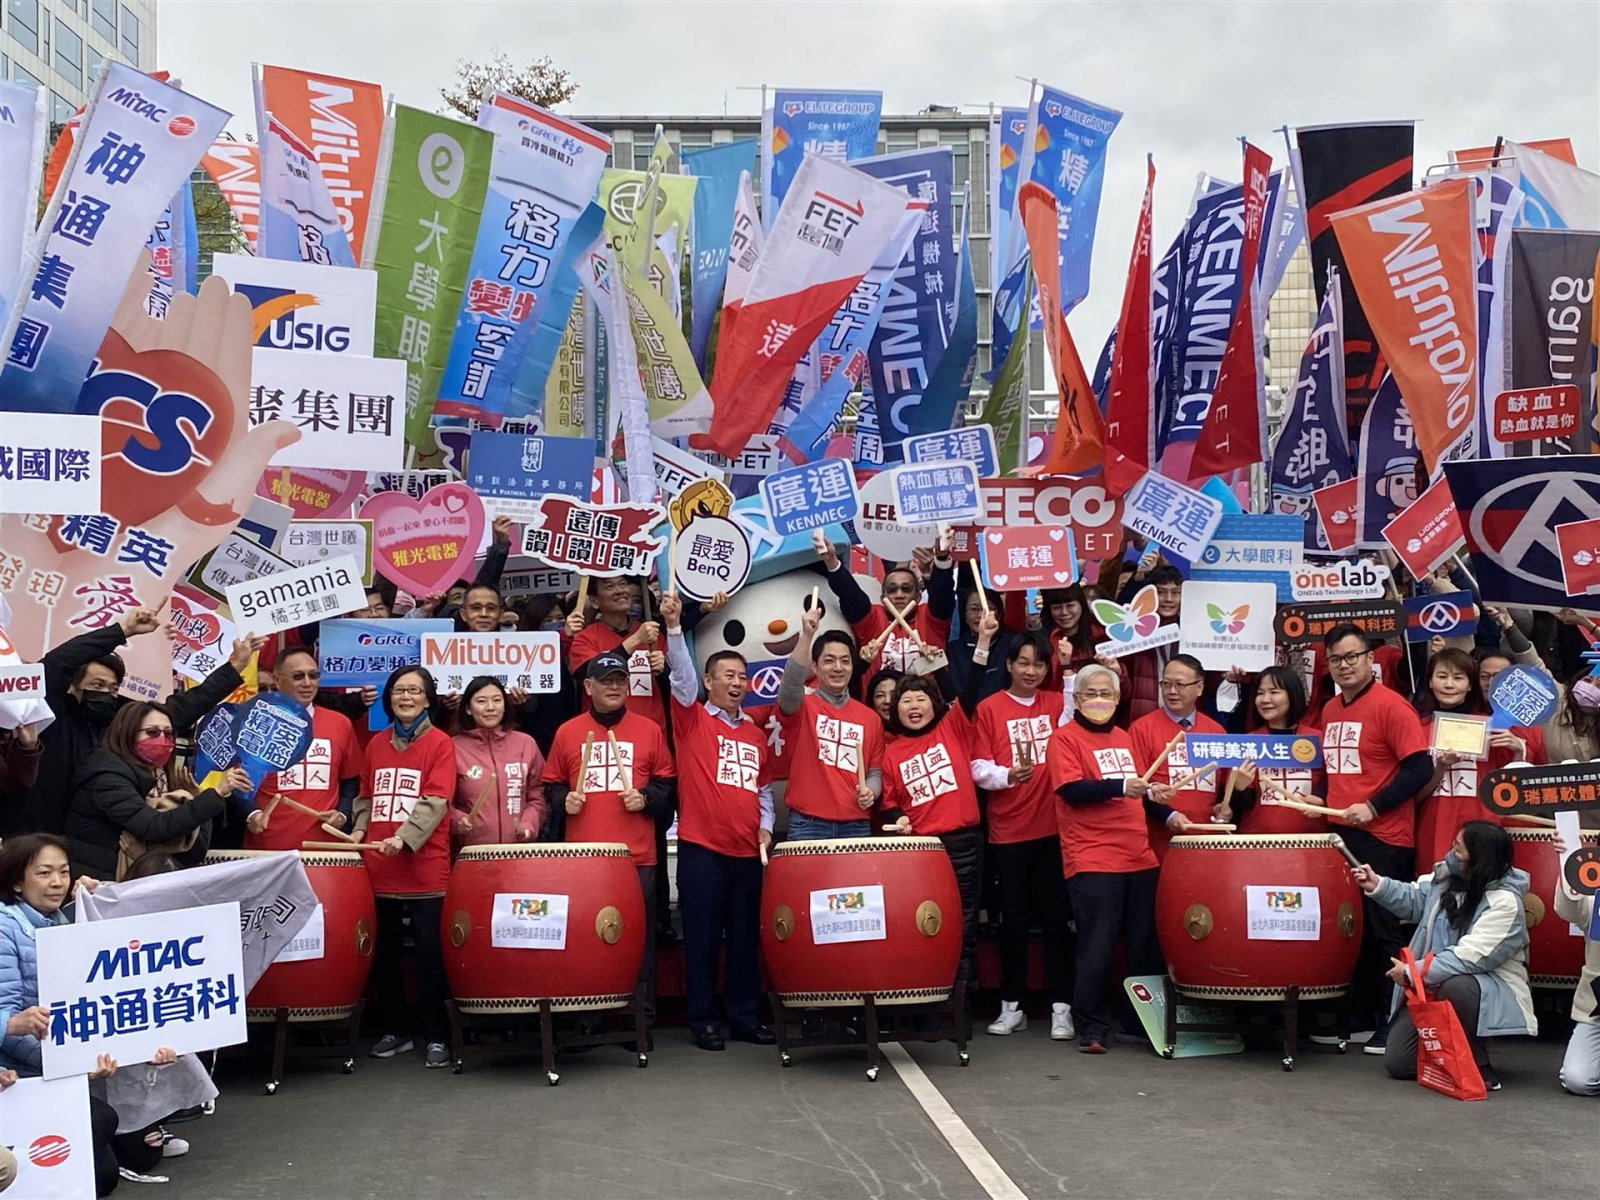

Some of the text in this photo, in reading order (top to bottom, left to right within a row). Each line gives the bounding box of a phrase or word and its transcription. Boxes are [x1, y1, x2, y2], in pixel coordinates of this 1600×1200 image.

[107, 87, 169, 123] MiTAC
[805, 100, 875, 115] ELITEGROUP
[531, 125, 561, 144] GREE
[808, 122, 830, 131] Since
[805, 200, 859, 238] FET
[6, 131, 145, 368] 神通集團
[268, 318, 350, 351] USIG
[1500, 414, 1575, 435] 熱血就是你
[769, 467, 851, 518] 廣運
[900, 468, 965, 490] 熱血廣運
[902, 489, 970, 513] 捐血傳愛
[1131, 479, 1215, 541] 廣運
[567, 509, 620, 540] 遠傳
[785, 507, 847, 533] KENMEC
[289, 529, 357, 546] 台灣世曦
[1132, 517, 1187, 553] KENMEC
[226, 543, 285, 578] 台灣世
[392, 541, 459, 568] 雅光電器
[690, 534, 735, 565] 最愛
[1008, 546, 1054, 569] 廣運
[1225, 547, 1293, 564] 大學眼科
[534, 571, 574, 588] FET
[687, 556, 731, 582] BenQ
[1019, 574, 1044, 582] KENMEC
[1295, 566, 1377, 589] onelab
[239, 568, 351, 618] gamania
[1325, 588, 1364, 596] Technology
[270, 593, 340, 625] 橘子集團
[375, 635, 417, 646] GREE
[425, 638, 556, 671] Mitutoyo
[0, 672, 41, 692] wer
[1502, 675, 1549, 714] 精英
[1492, 687, 1537, 726] 電腦
[245, 709, 303, 750] 精英
[237, 729, 291, 769] 電腦
[1192, 740, 1291, 761] 研華美滿人生
[376, 771, 418, 793] 捐血
[86, 935, 206, 983] MiTAC
[49, 973, 240, 1045] 神通資科
